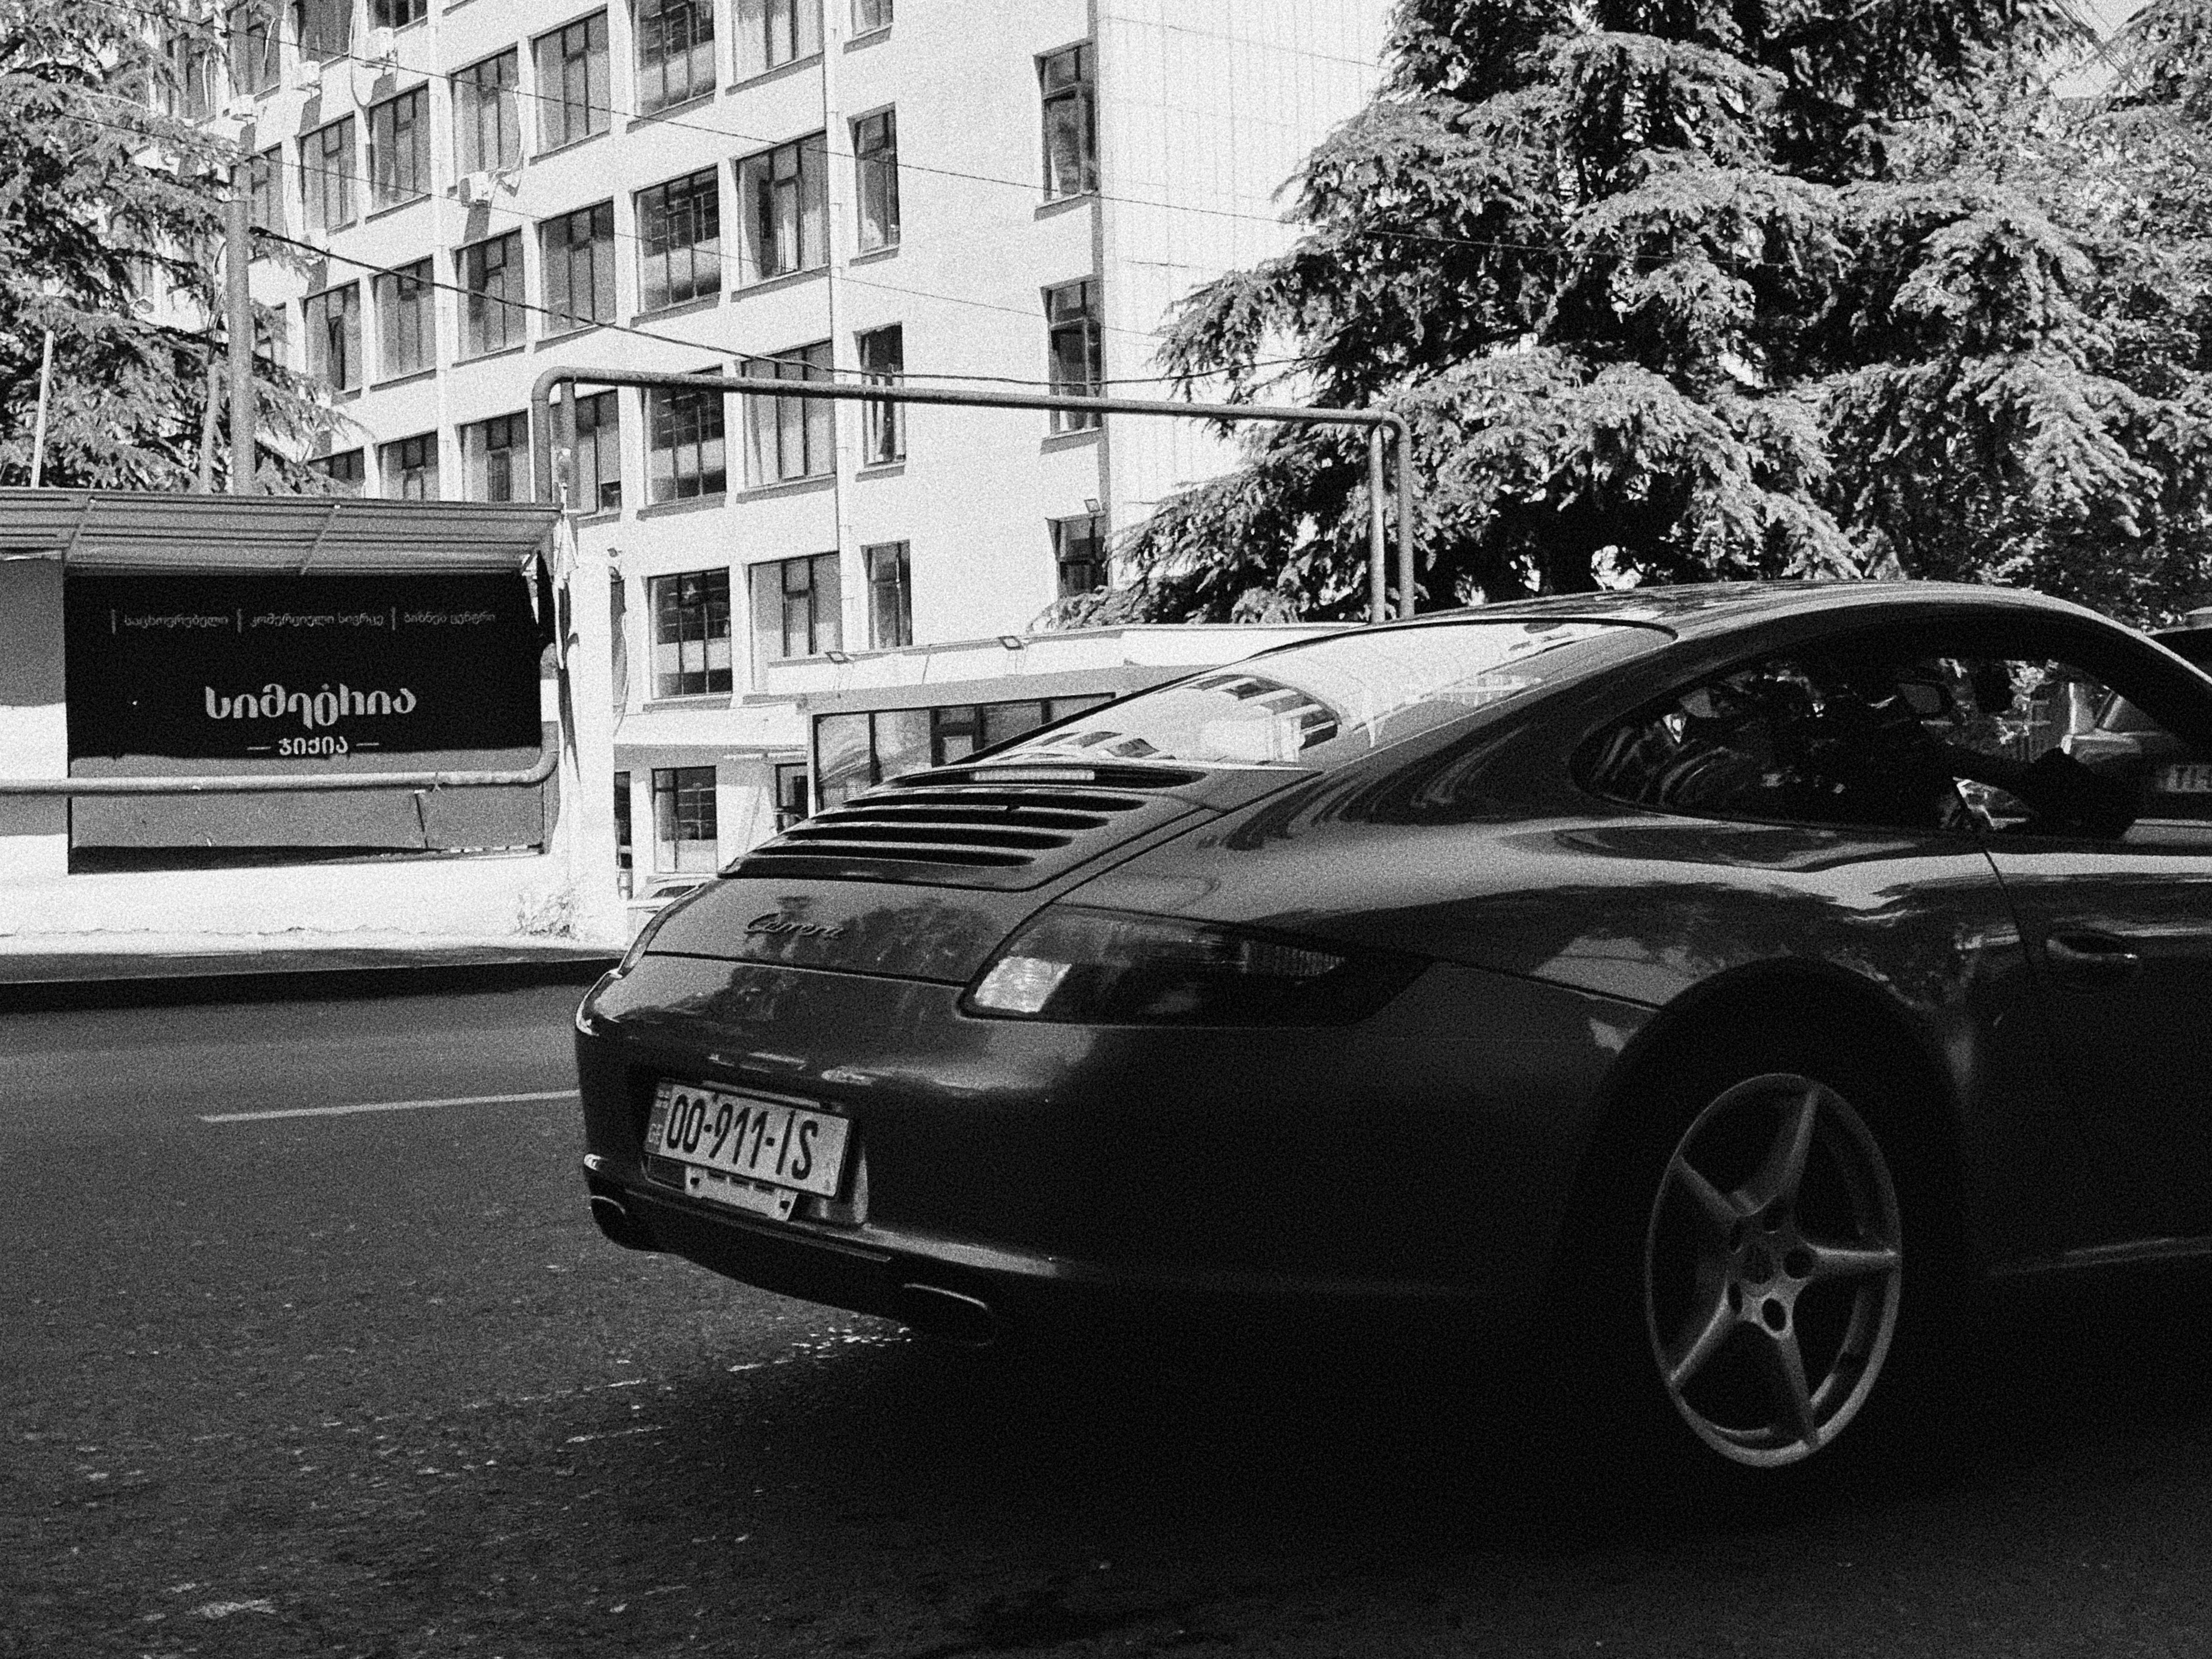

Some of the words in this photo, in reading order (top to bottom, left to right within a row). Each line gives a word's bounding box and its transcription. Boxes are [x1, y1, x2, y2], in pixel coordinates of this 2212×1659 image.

[125, 614, 229, 628] საცხოვრებელი
[251, 612, 334, 627] კომერციული
[338, 612, 384, 626] სივრცე
[450, 611, 495, 624] ცენტრი
[205, 683, 417, 730] სიმეტრია
[278, 736, 348, 756] ჯიქია
